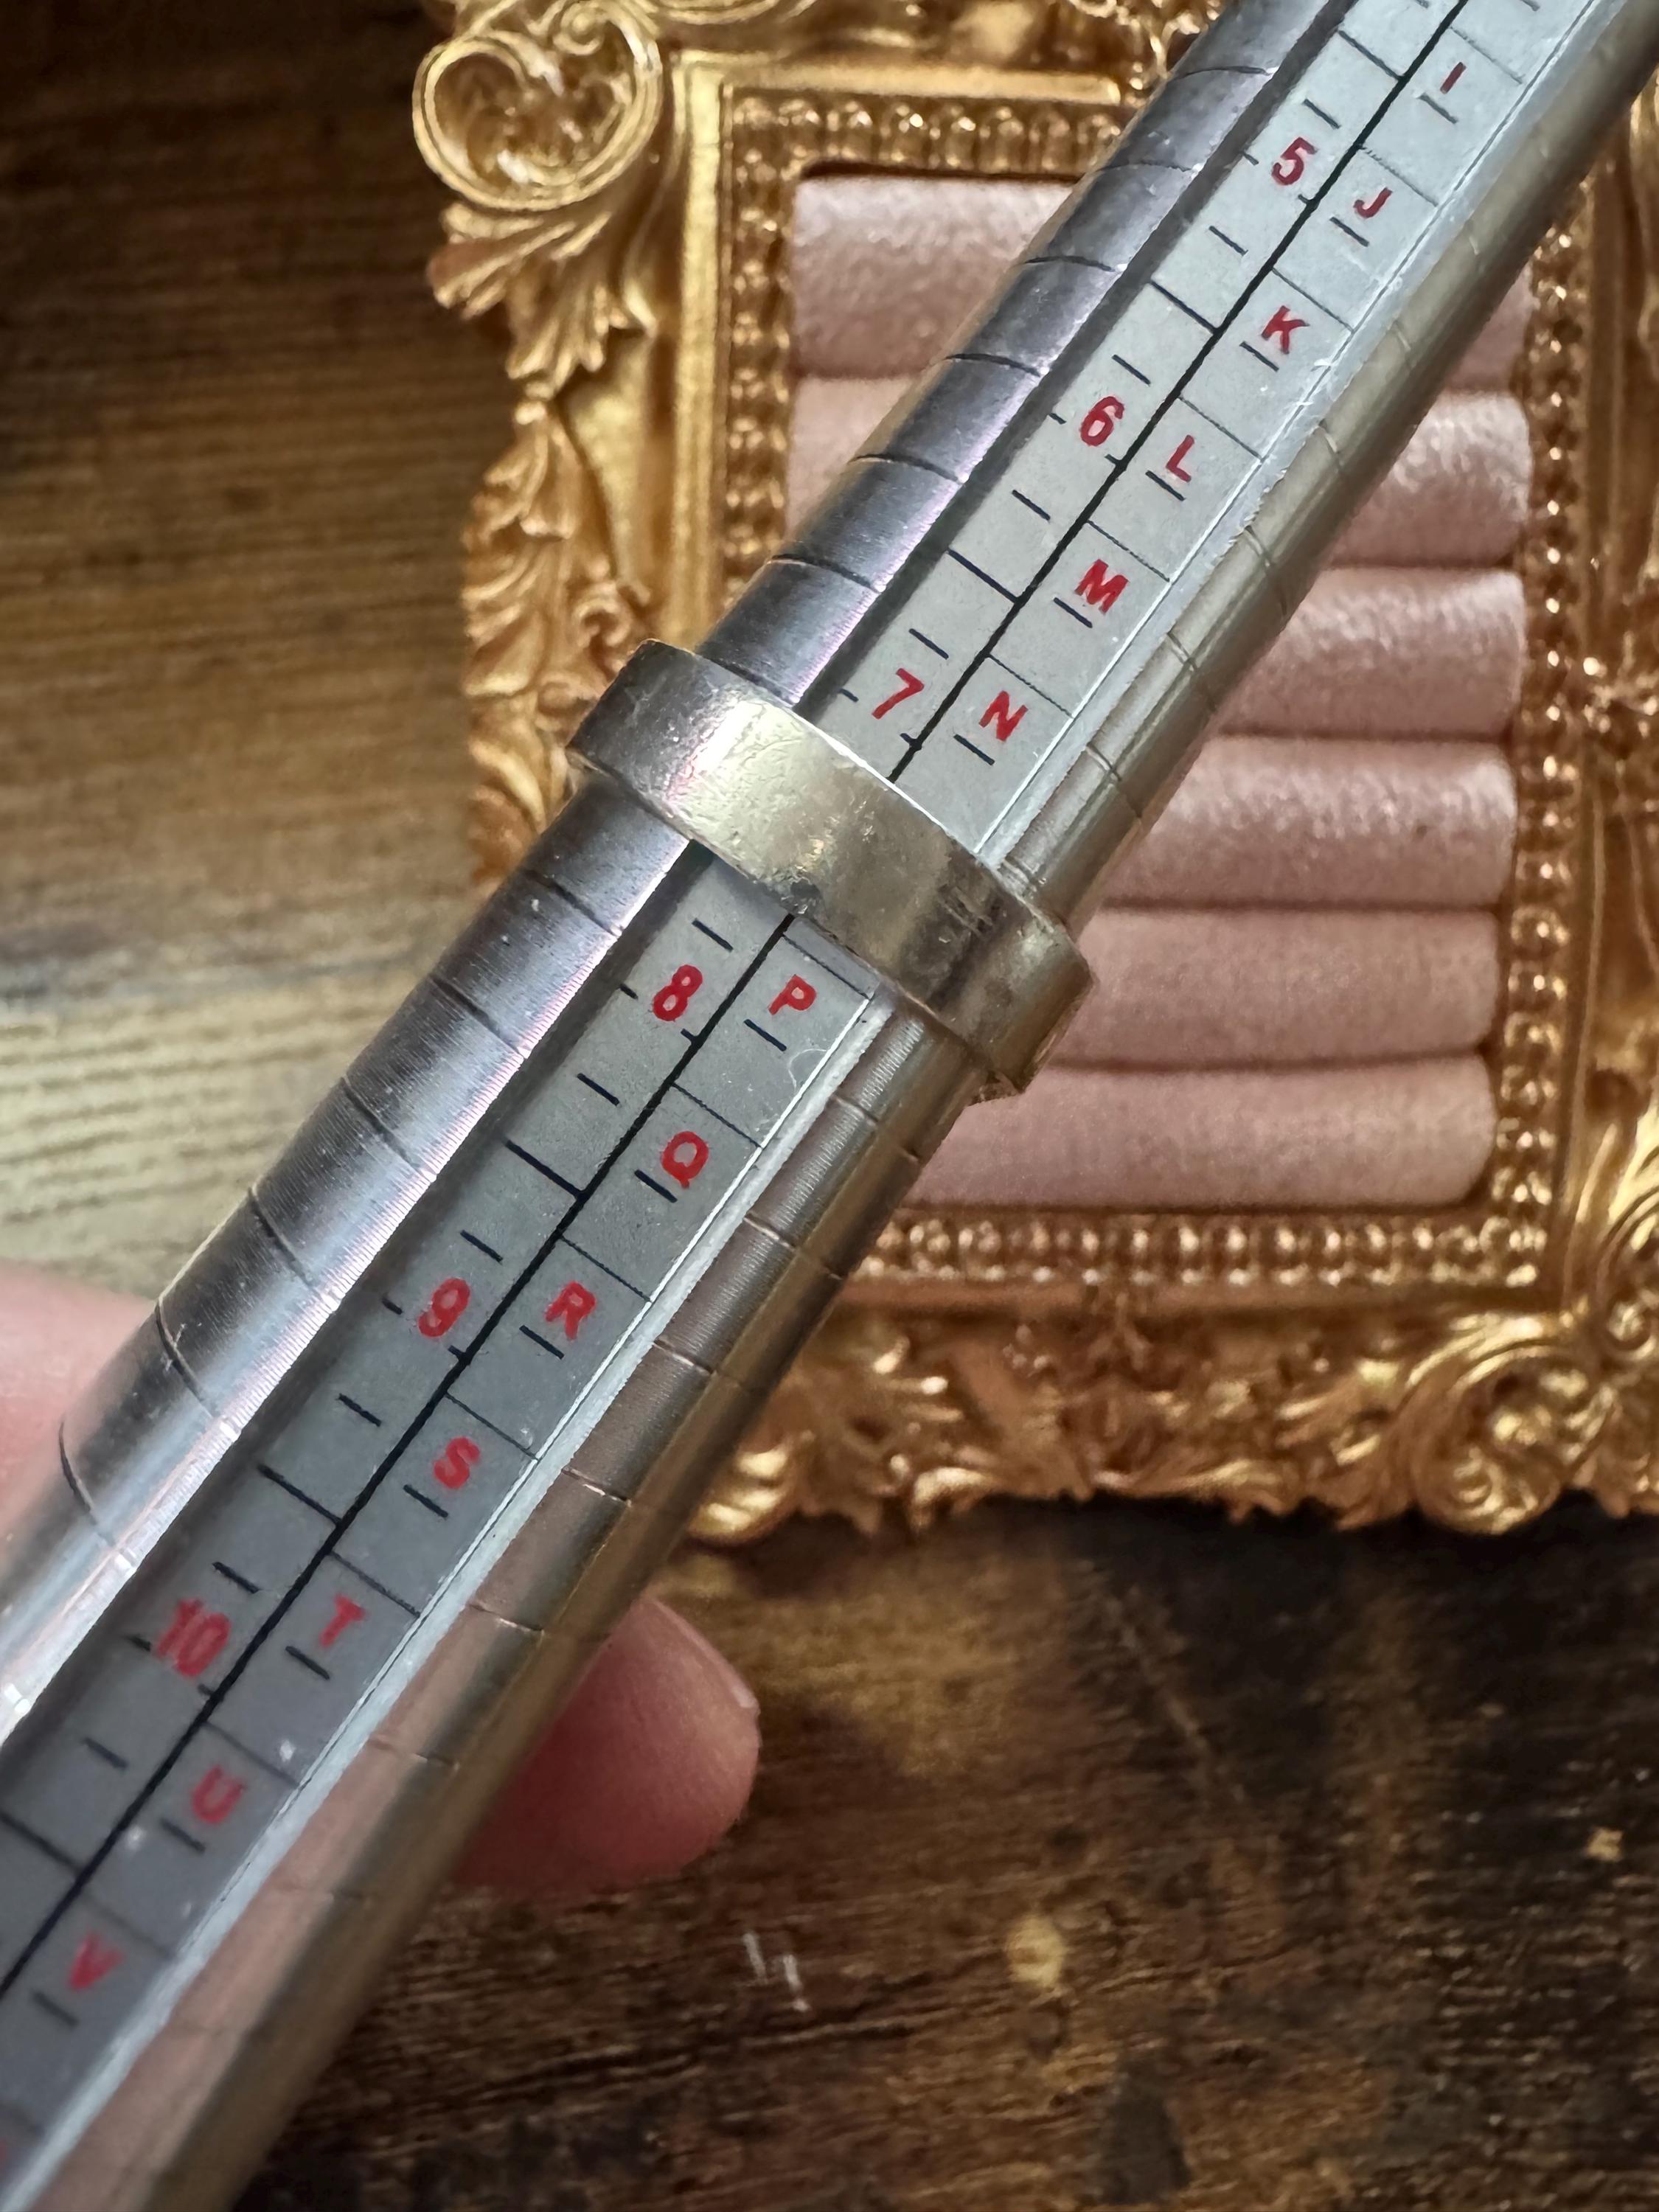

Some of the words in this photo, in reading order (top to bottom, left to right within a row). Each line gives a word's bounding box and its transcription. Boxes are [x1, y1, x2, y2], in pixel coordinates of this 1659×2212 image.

[1440, 61, 1466, 94] I
[1271, 137, 1316, 186] 5
[1354, 188, 1392, 219] J
[1262, 305, 1309, 353] K
[1079, 396, 1124, 446] 6
[1165, 435, 1194, 481] L
[1075, 559, 1129, 613] M
[872, 668, 925, 720] 7
[979, 690, 1028, 742] N
[652, 964, 703, 1022] 8
[768, 975, 817, 1015] P
[661, 1130, 709, 1189] Q
[417, 1278, 470, 1338] 9
[545, 1281, 597, 1339] R
[432, 1436, 481, 1489] S
[153, 1598, 232, 1677] 10
[318, 1595, 366, 1648] T
[190, 1765, 246, 1824] U
[68, 1933, 122, 1989] V
